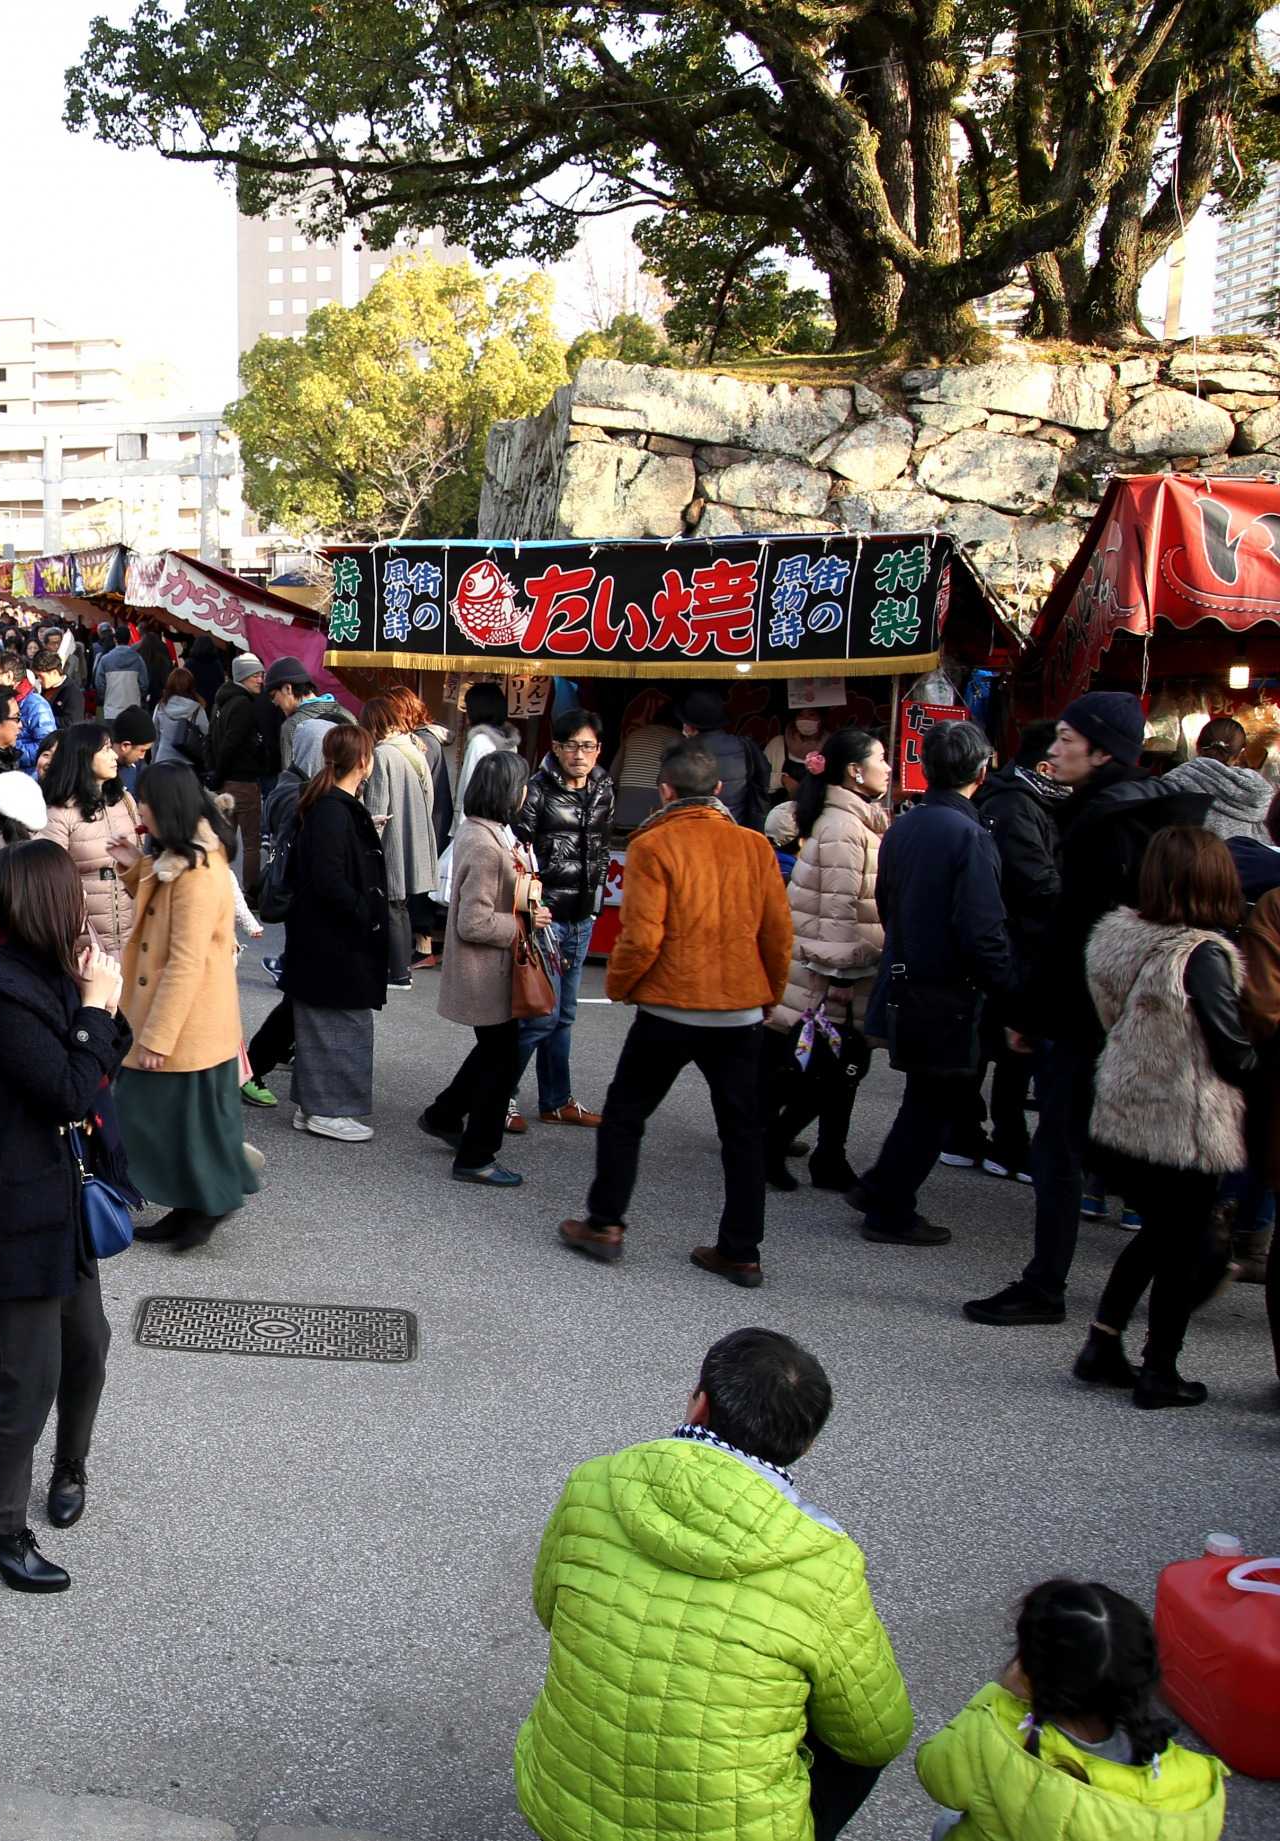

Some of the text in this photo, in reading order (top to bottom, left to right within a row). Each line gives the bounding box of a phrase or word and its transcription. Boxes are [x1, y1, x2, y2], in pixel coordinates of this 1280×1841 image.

[159, 569, 284, 638] からあ
[328, 556, 362, 642] 特製
[383, 558, 412, 642] 風物詩
[410, 561, 442, 631] 街の
[519, 558, 758, 655] たい焼
[769, 554, 811, 648] 風物詩
[808, 555, 850, 633] 街の
[870, 546, 930, 648] 特製
